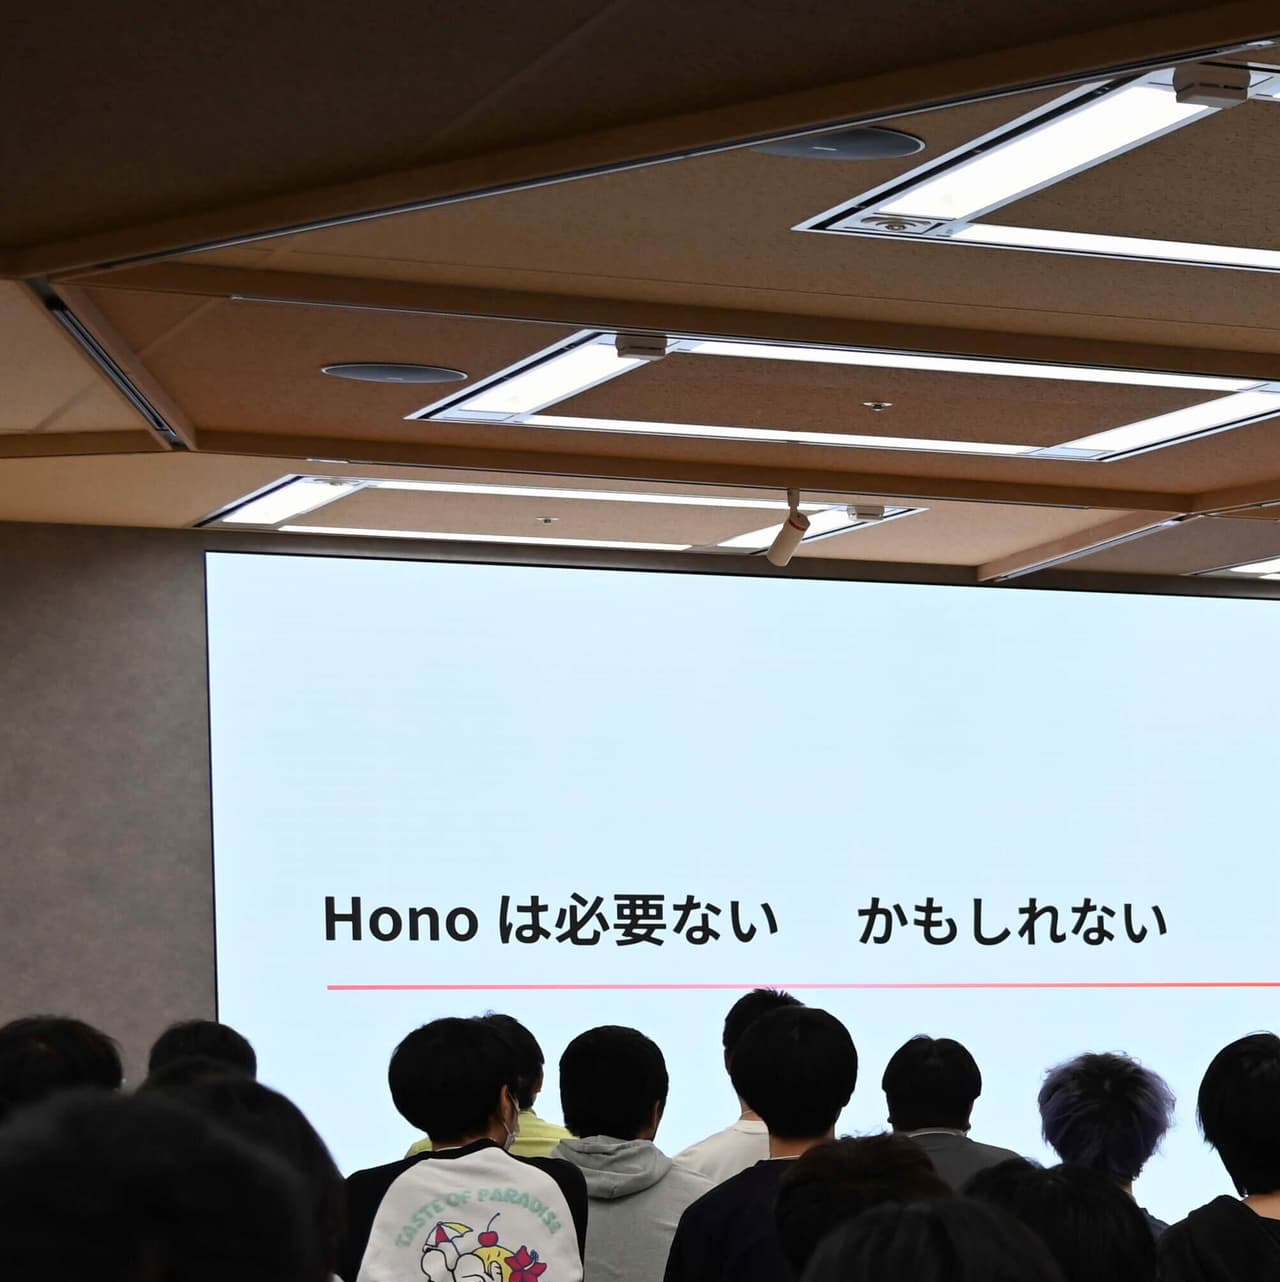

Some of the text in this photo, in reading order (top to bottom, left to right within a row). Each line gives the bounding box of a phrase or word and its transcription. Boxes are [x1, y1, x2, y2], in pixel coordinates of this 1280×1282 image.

[325, 892, 1167, 947] Hono は必要ない かもしれない
[396, 1199, 445, 1247] TASTE
[446, 1190, 472, 1208] OF
